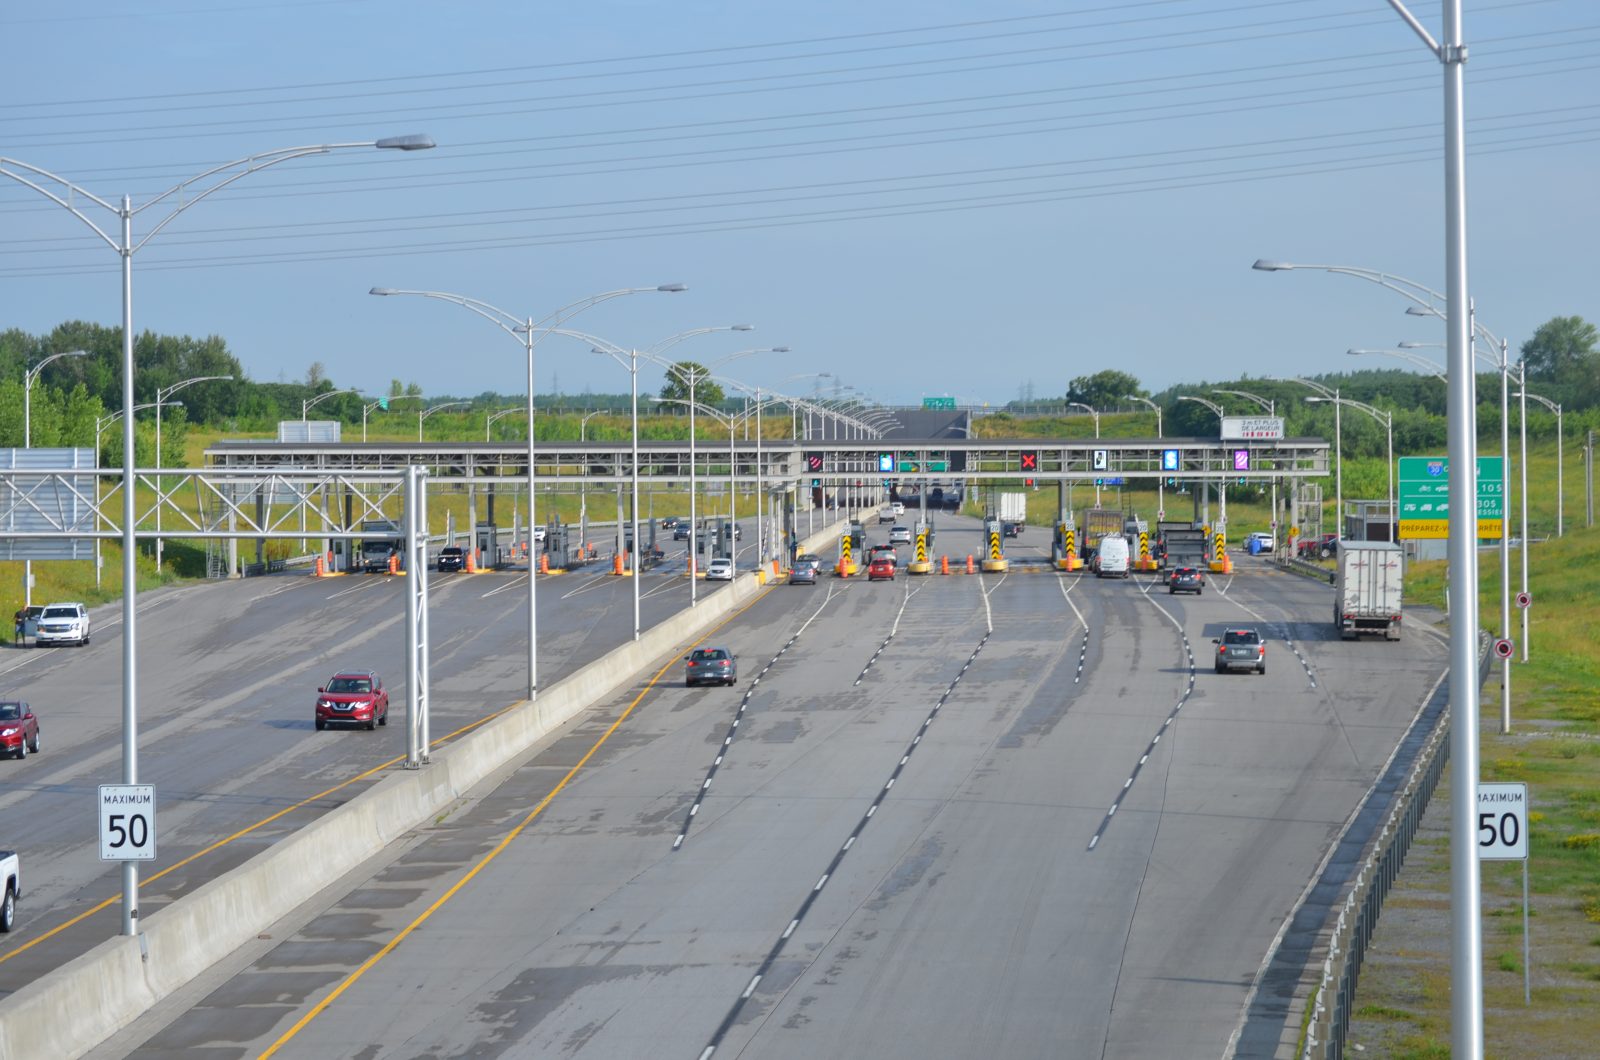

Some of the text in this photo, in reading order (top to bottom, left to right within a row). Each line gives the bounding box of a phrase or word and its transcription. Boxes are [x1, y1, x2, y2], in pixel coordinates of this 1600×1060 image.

[104, 795, 150, 804] MAXIMUM
[109, 814, 148, 848] 50
[1479, 812, 1519, 847] 50
